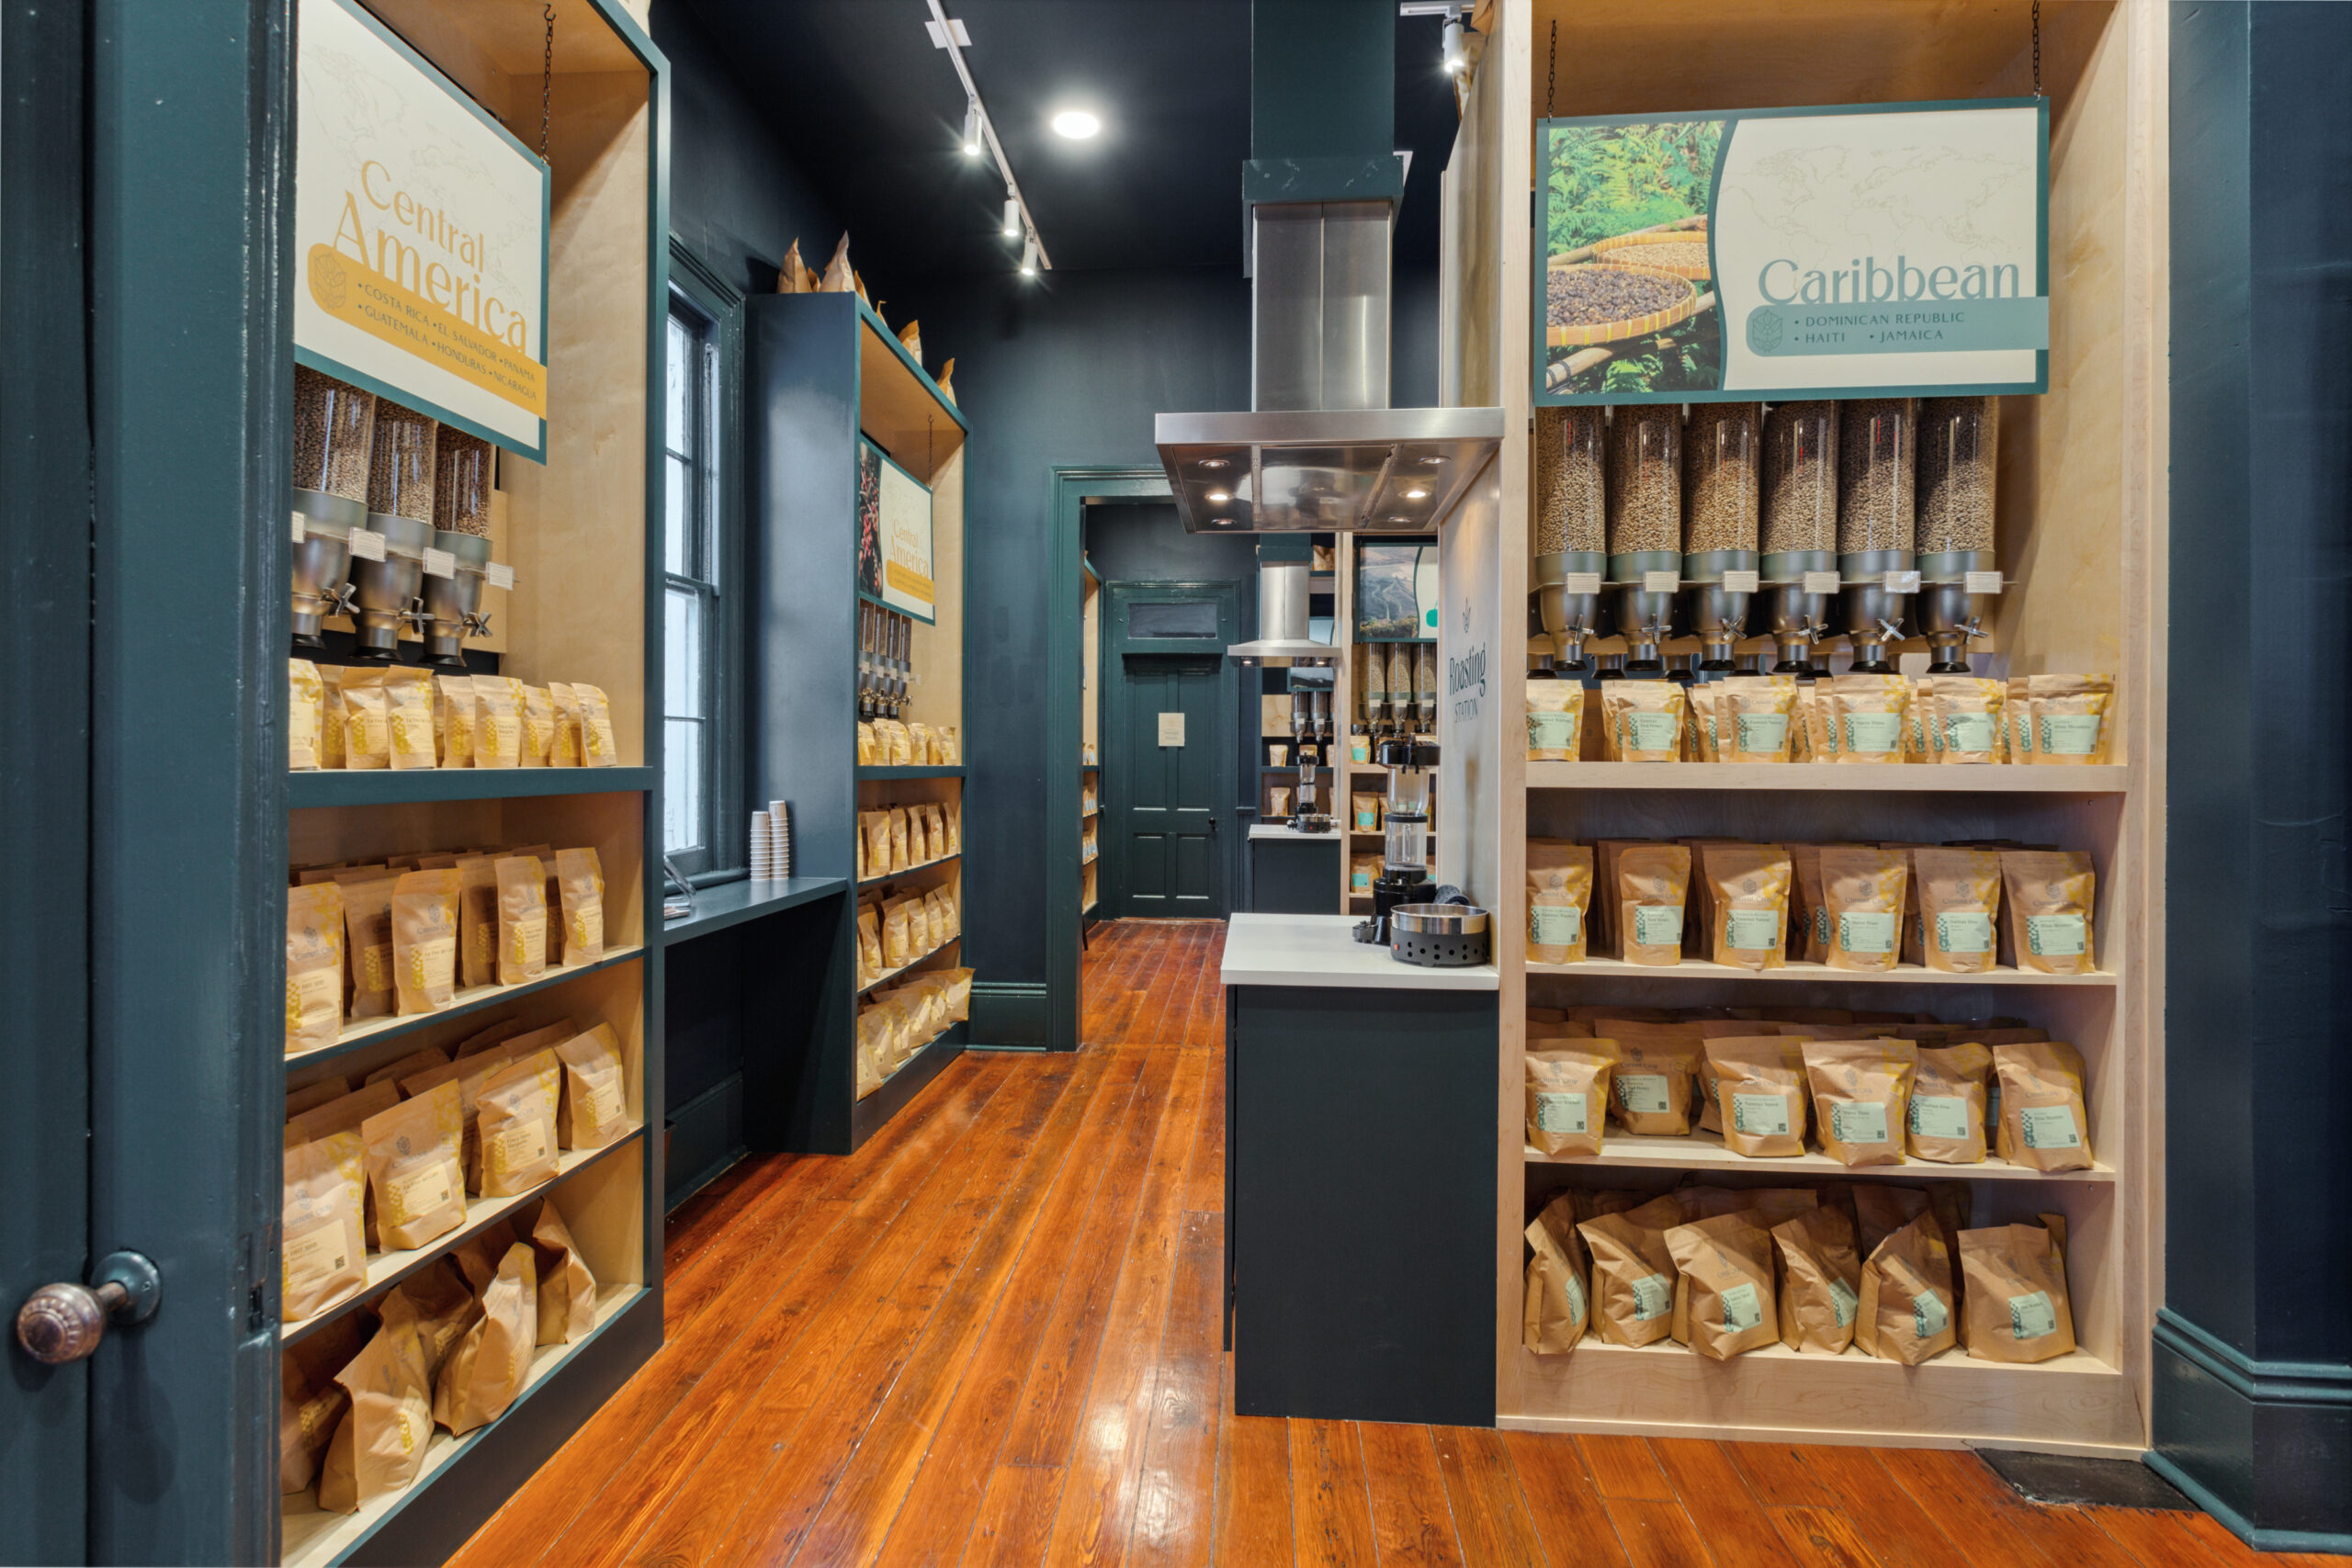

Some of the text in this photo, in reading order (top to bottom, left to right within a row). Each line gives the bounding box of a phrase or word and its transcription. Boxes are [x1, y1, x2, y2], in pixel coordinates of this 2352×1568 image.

[361, 160, 485, 273] Central
[333, 189, 527, 355] America
[1758, 255, 2019, 304] Caribbean
[364, 284, 535, 383] COSTA RICA EL SALVADOR PANAMA
[1804, 311, 1965, 328] DOMINICAN REPUBLIC
[1804, 330, 1944, 344] HAITI JAMAICA
[365, 305, 537, 401] GUATEMALA HONDURAS NICARAGUA
[892, 518, 918, 549] Central
[889, 536, 929, 581] America
[1449, 642, 1487, 698] Roasting
[1454, 697, 1478, 724] STATION
